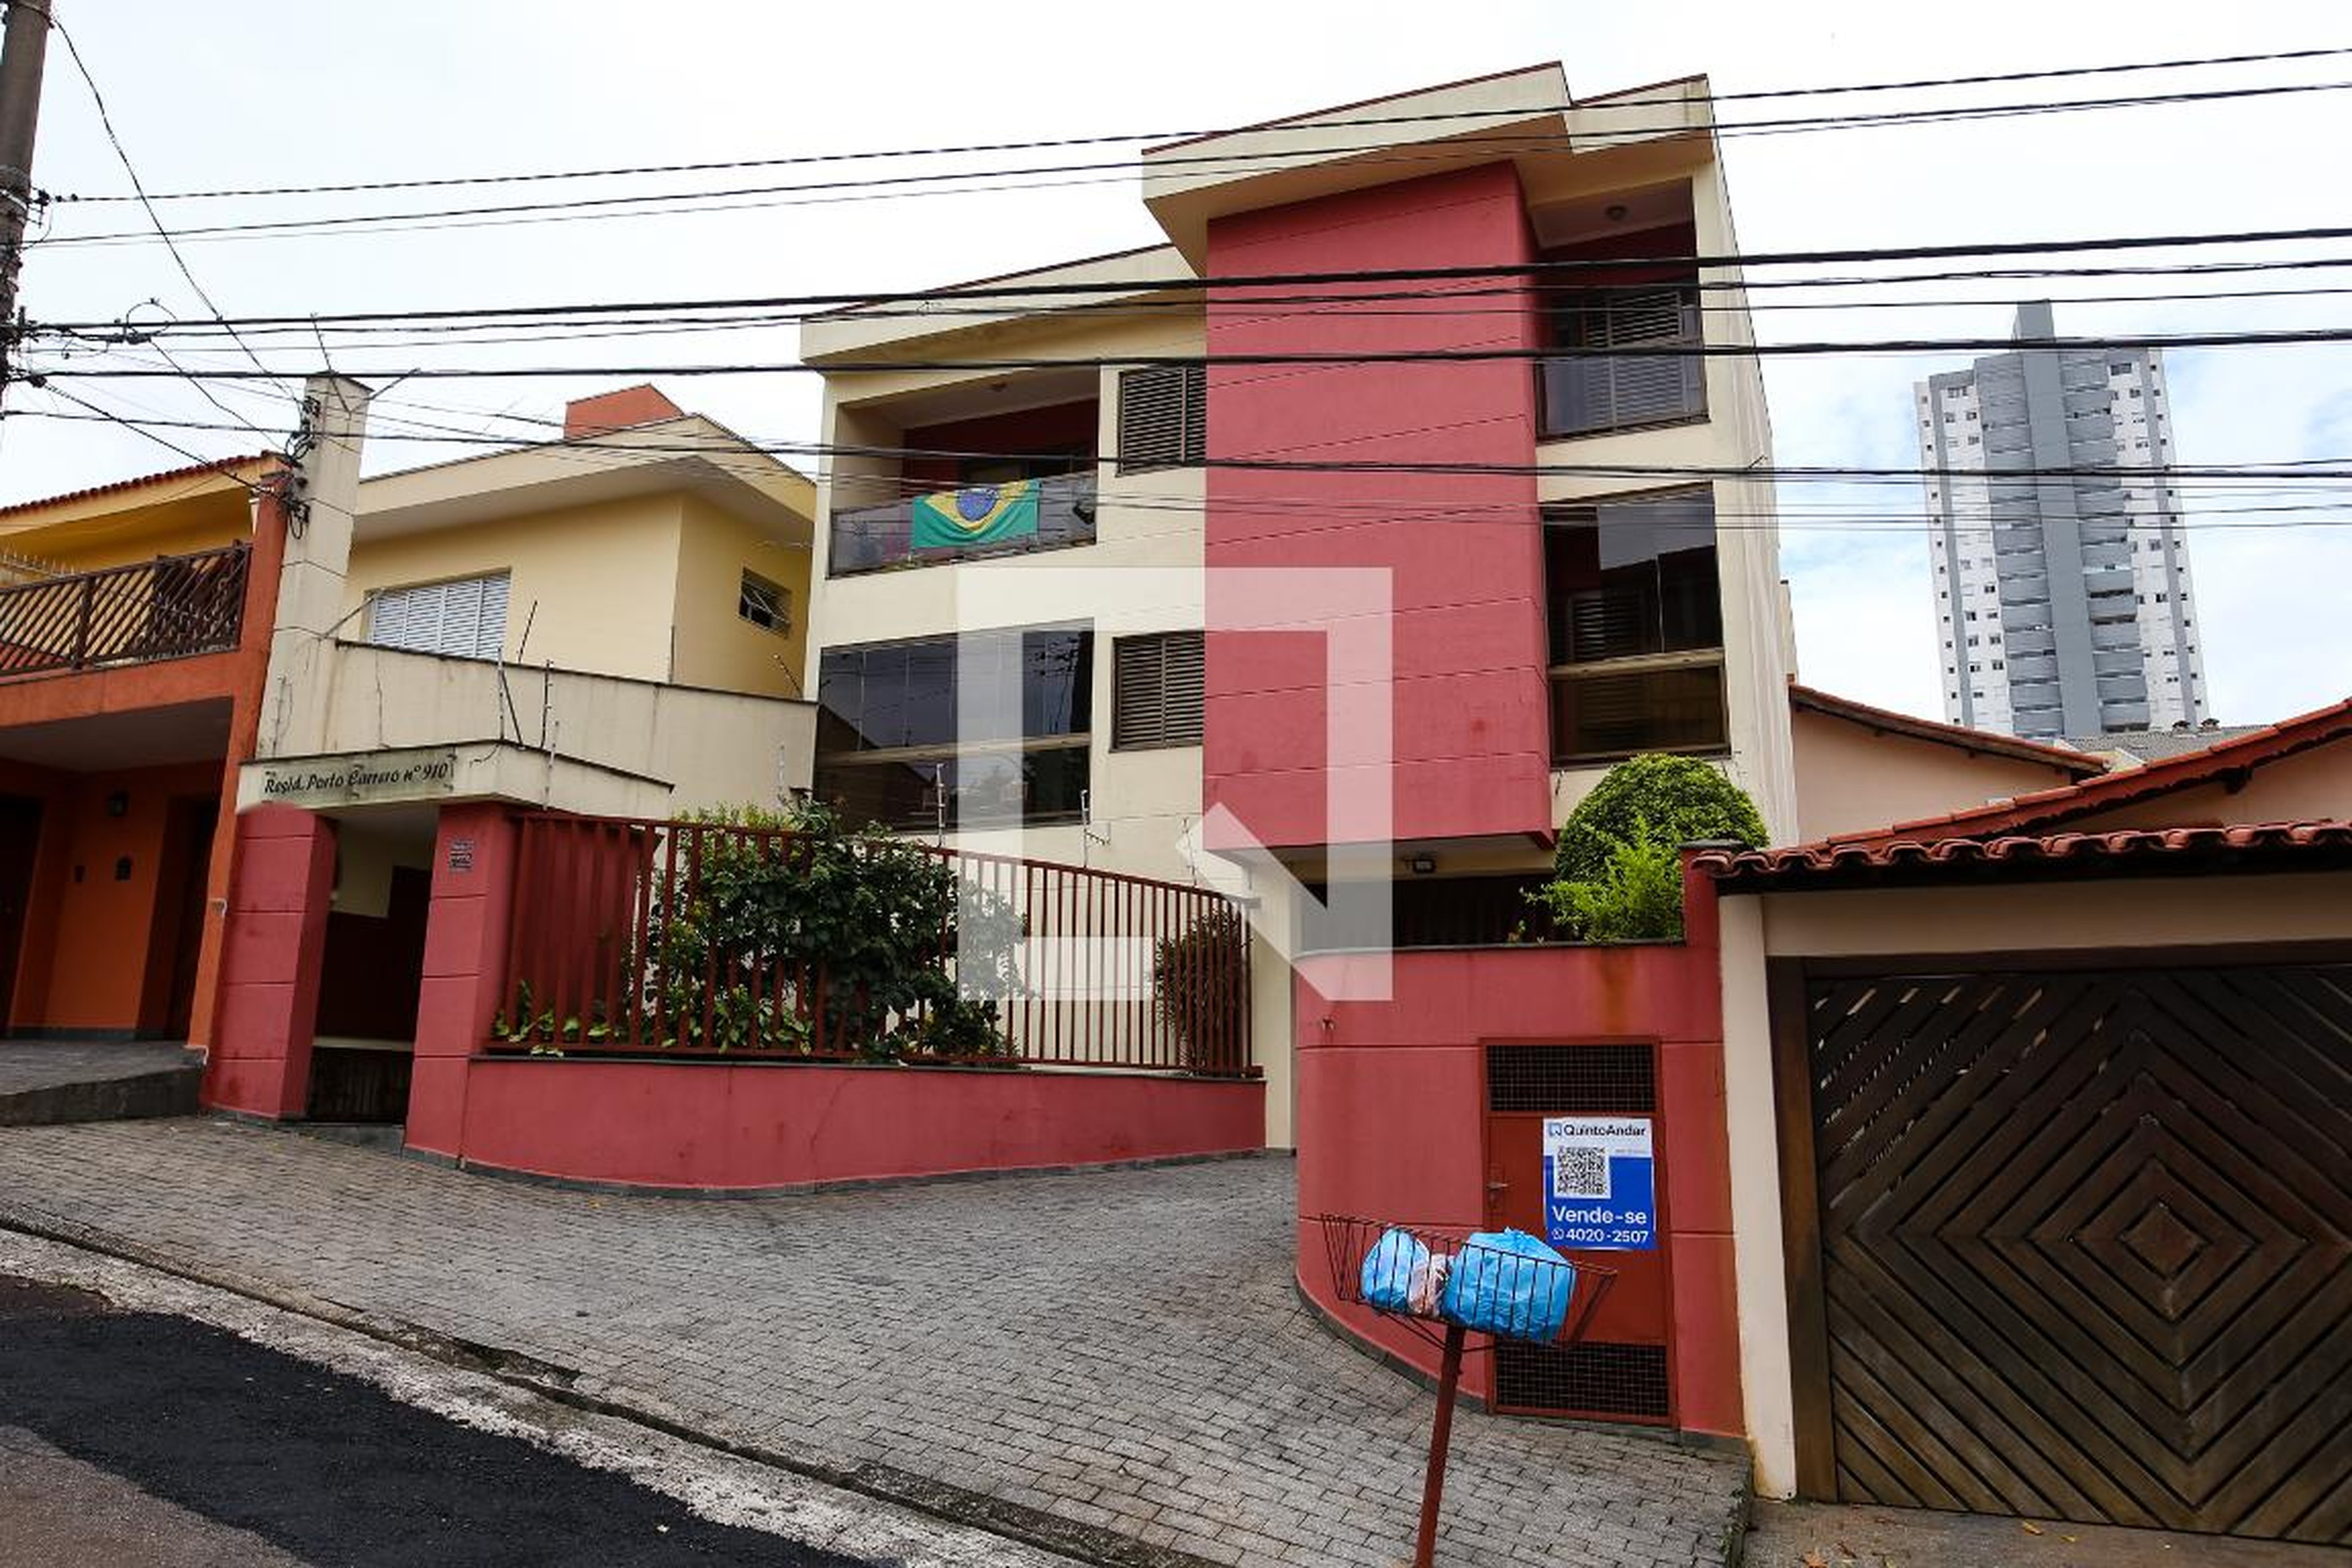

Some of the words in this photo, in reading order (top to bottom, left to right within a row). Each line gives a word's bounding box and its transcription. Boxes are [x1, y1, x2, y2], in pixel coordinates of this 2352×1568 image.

[306, 772, 344, 790] Porto
[422, 763, 448, 780] 910
[1564, 1124, 1646, 1136] QuintoAndar
[1552, 1205, 1648, 1224] Vende-se
